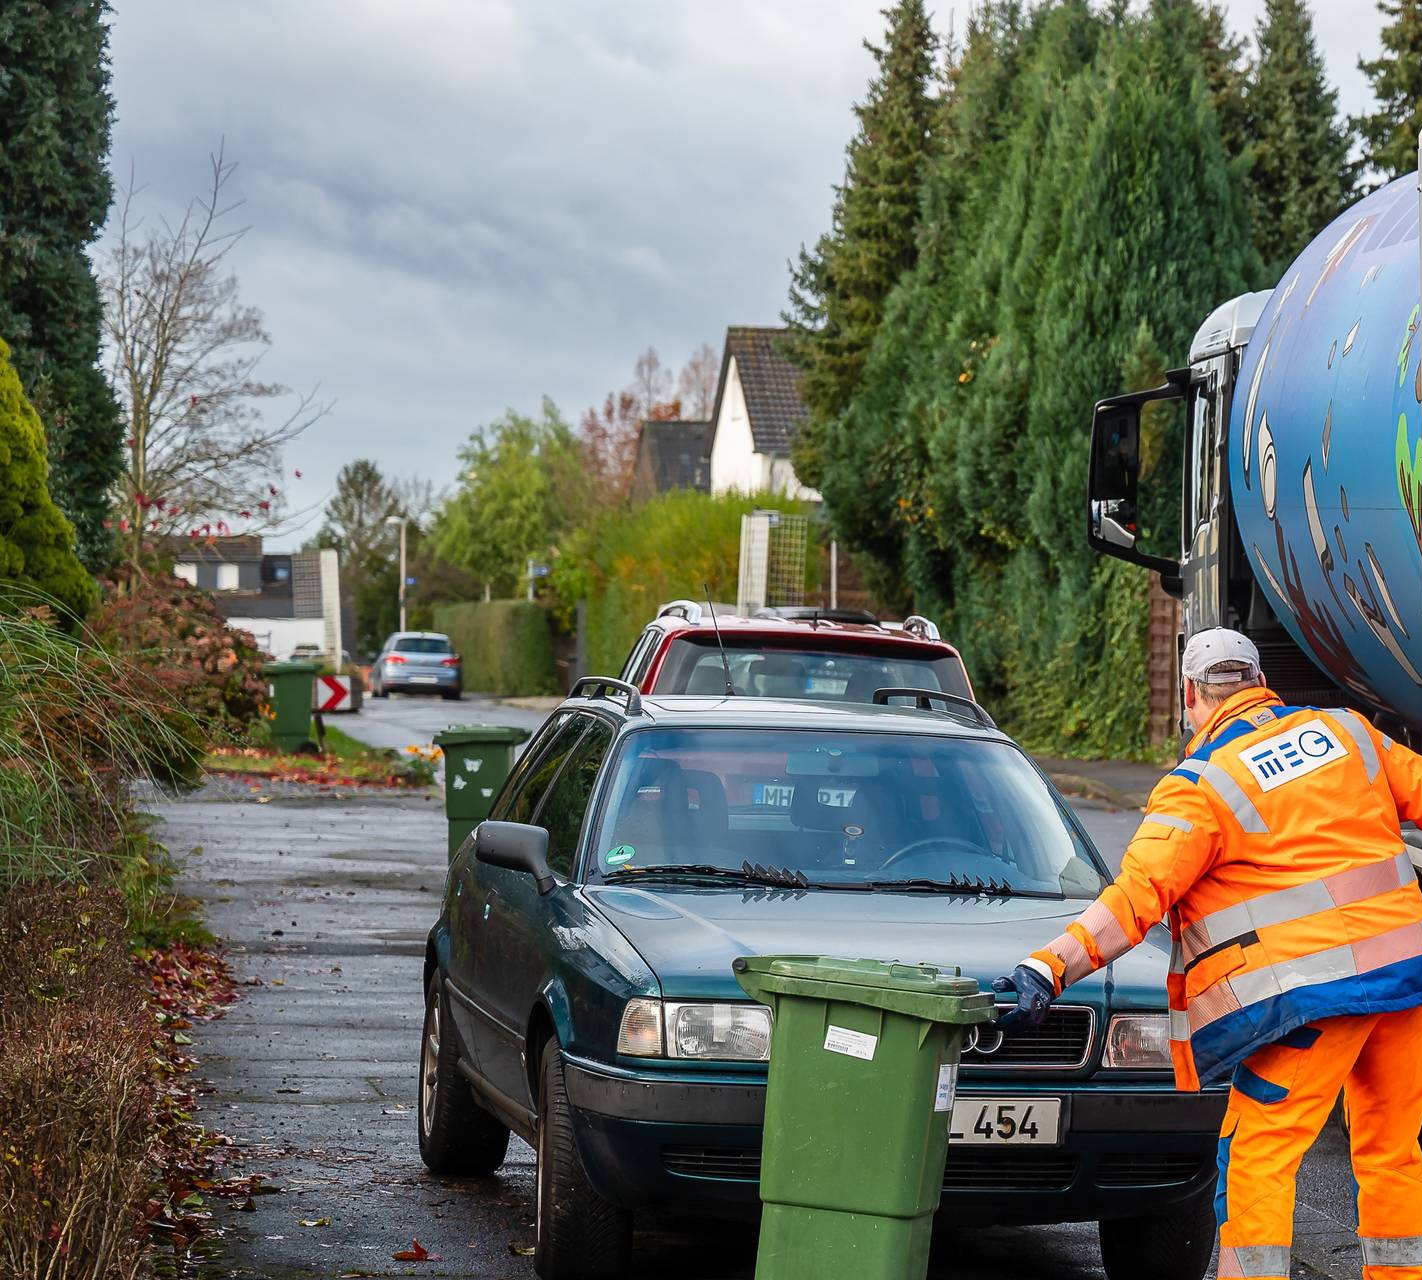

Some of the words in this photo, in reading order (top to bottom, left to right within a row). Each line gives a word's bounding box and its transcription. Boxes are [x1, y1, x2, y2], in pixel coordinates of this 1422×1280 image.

[765, 787, 792, 807] MH
[615, 846, 625, 855] 4
[973, 1105, 1039, 1139] 454
